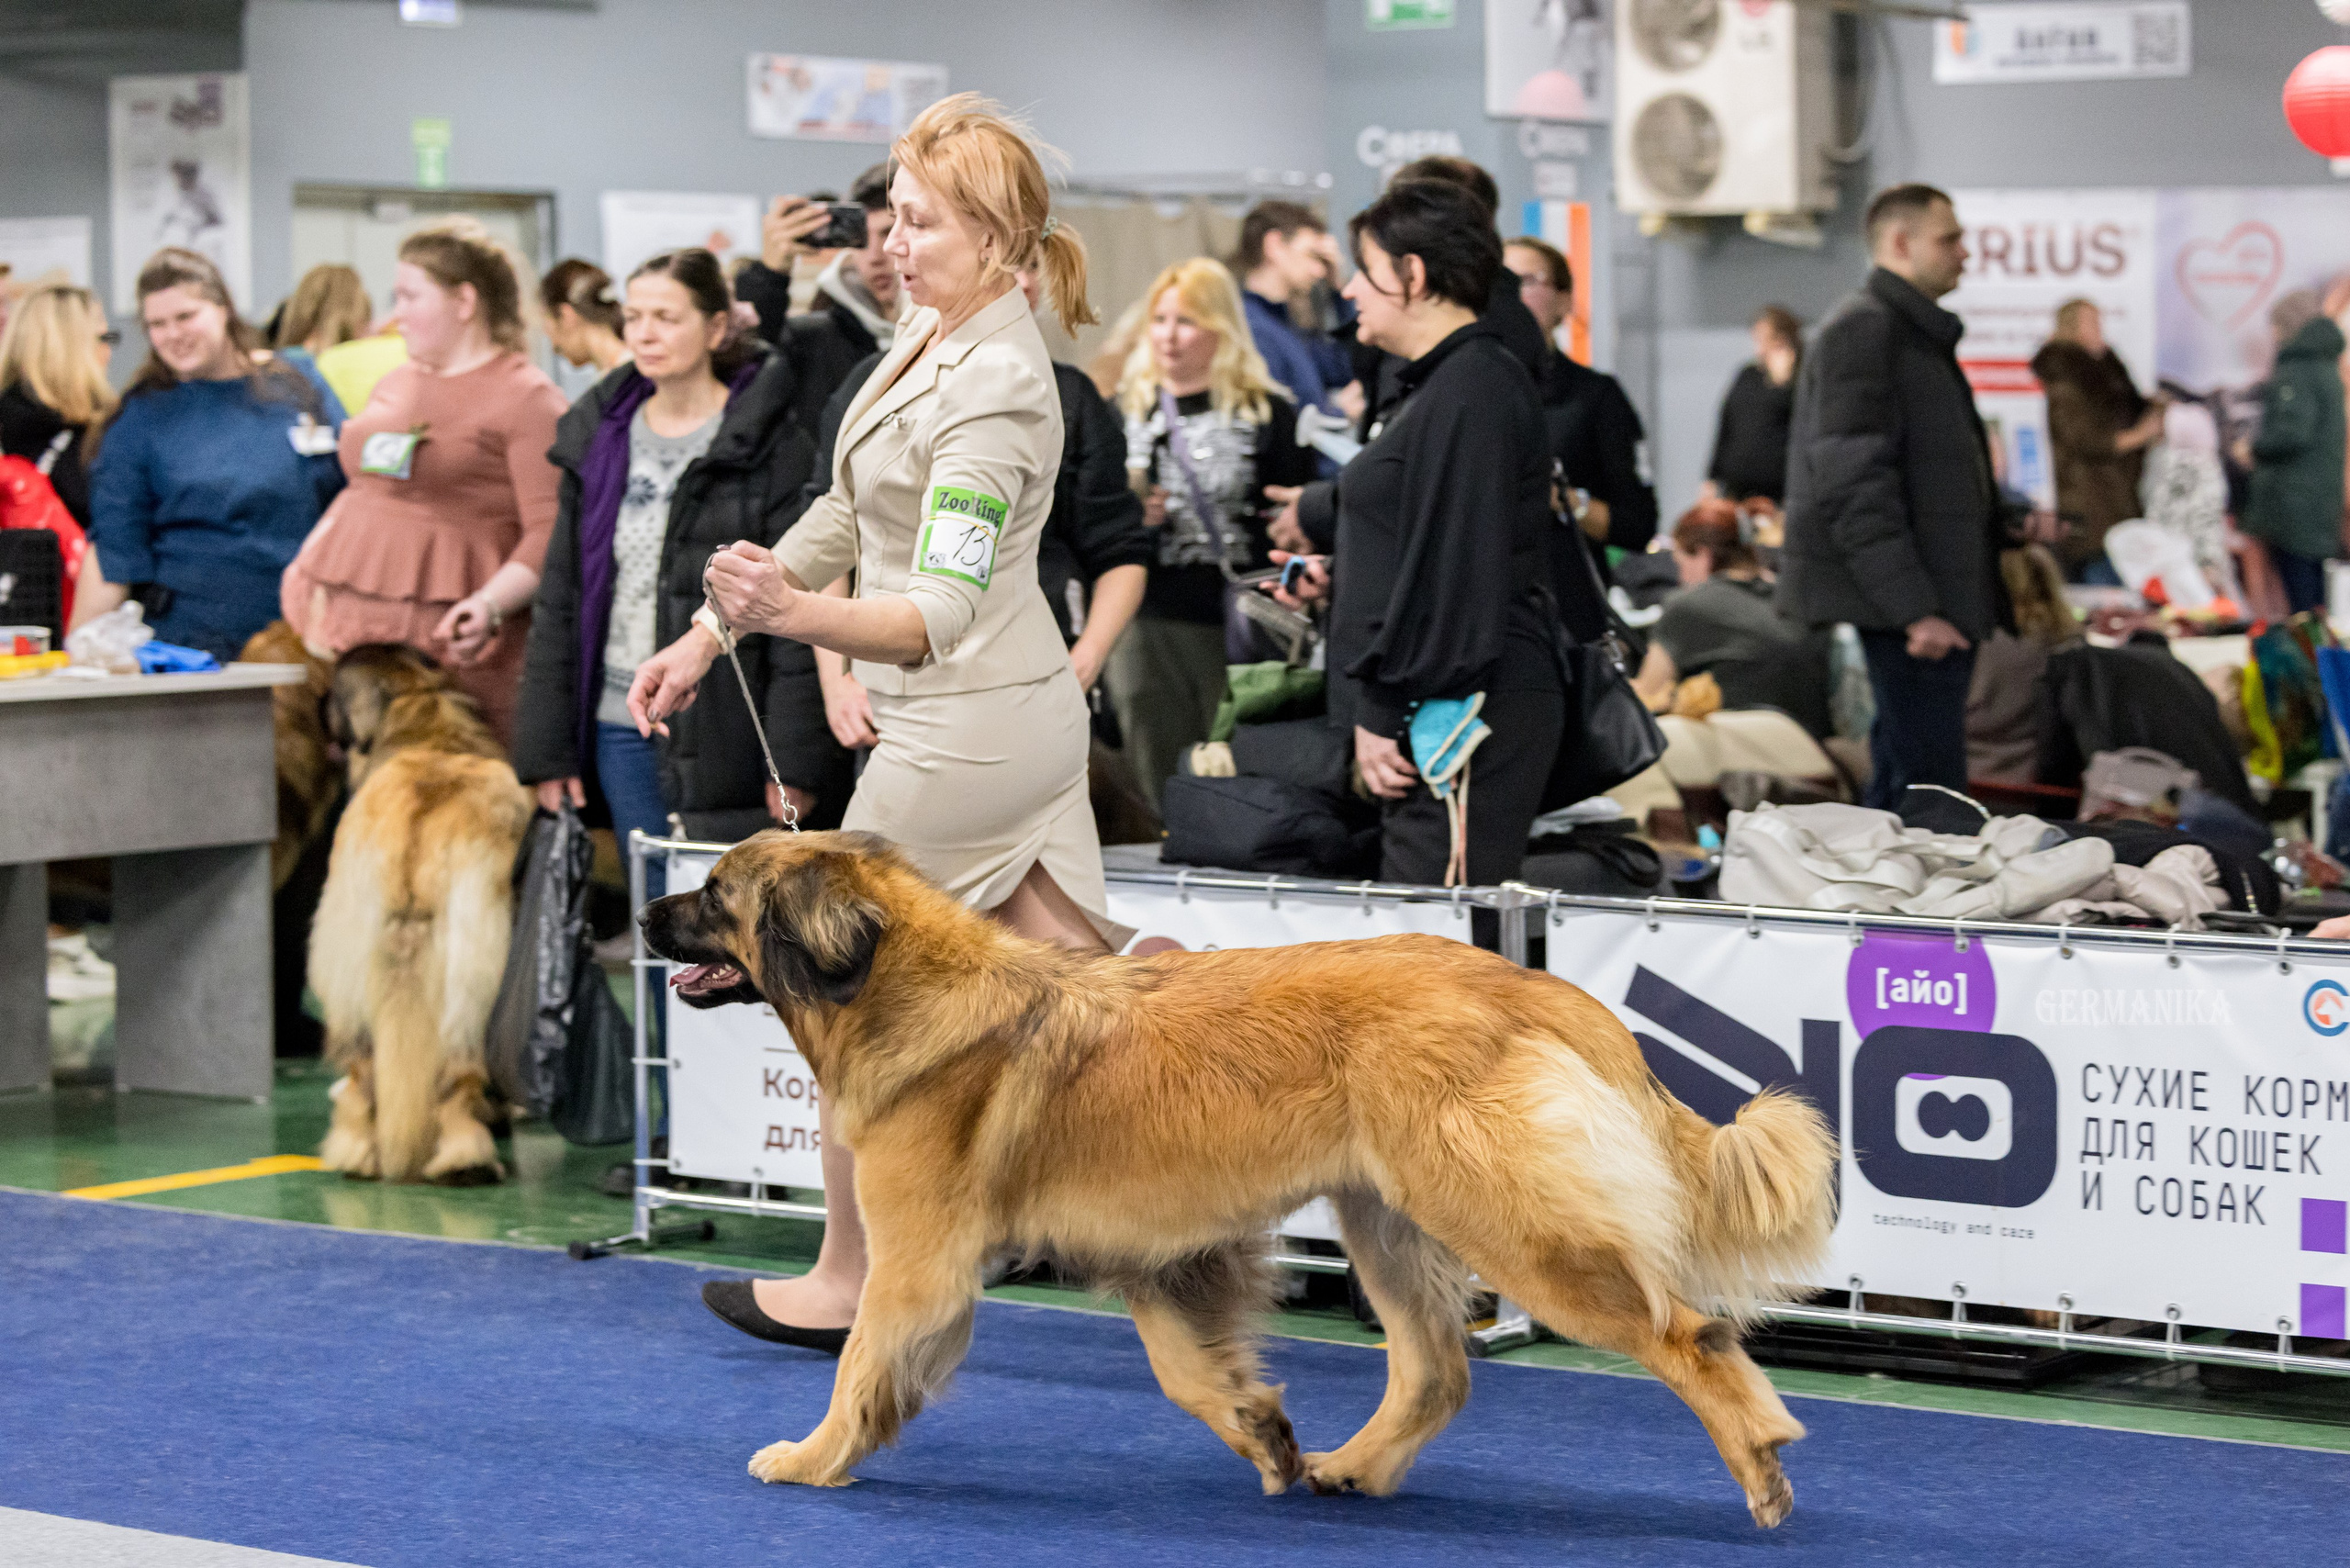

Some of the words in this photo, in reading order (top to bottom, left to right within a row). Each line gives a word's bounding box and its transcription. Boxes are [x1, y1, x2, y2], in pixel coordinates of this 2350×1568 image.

[952, 525, 990, 566] 13
[2082, 1062, 2210, 1112] СУХИЕ
[2080, 1116, 2155, 1165] ДЛЯ
[2190, 1125, 2322, 1175] КОШЕК
[2081, 1170, 2103, 1211] И
[2135, 1174, 2266, 1226] СОБАК
[1873, 1214, 1957, 1235] technology
[1966, 1222, 1992, 1236] and
[2000, 1226, 2035, 1239] care
